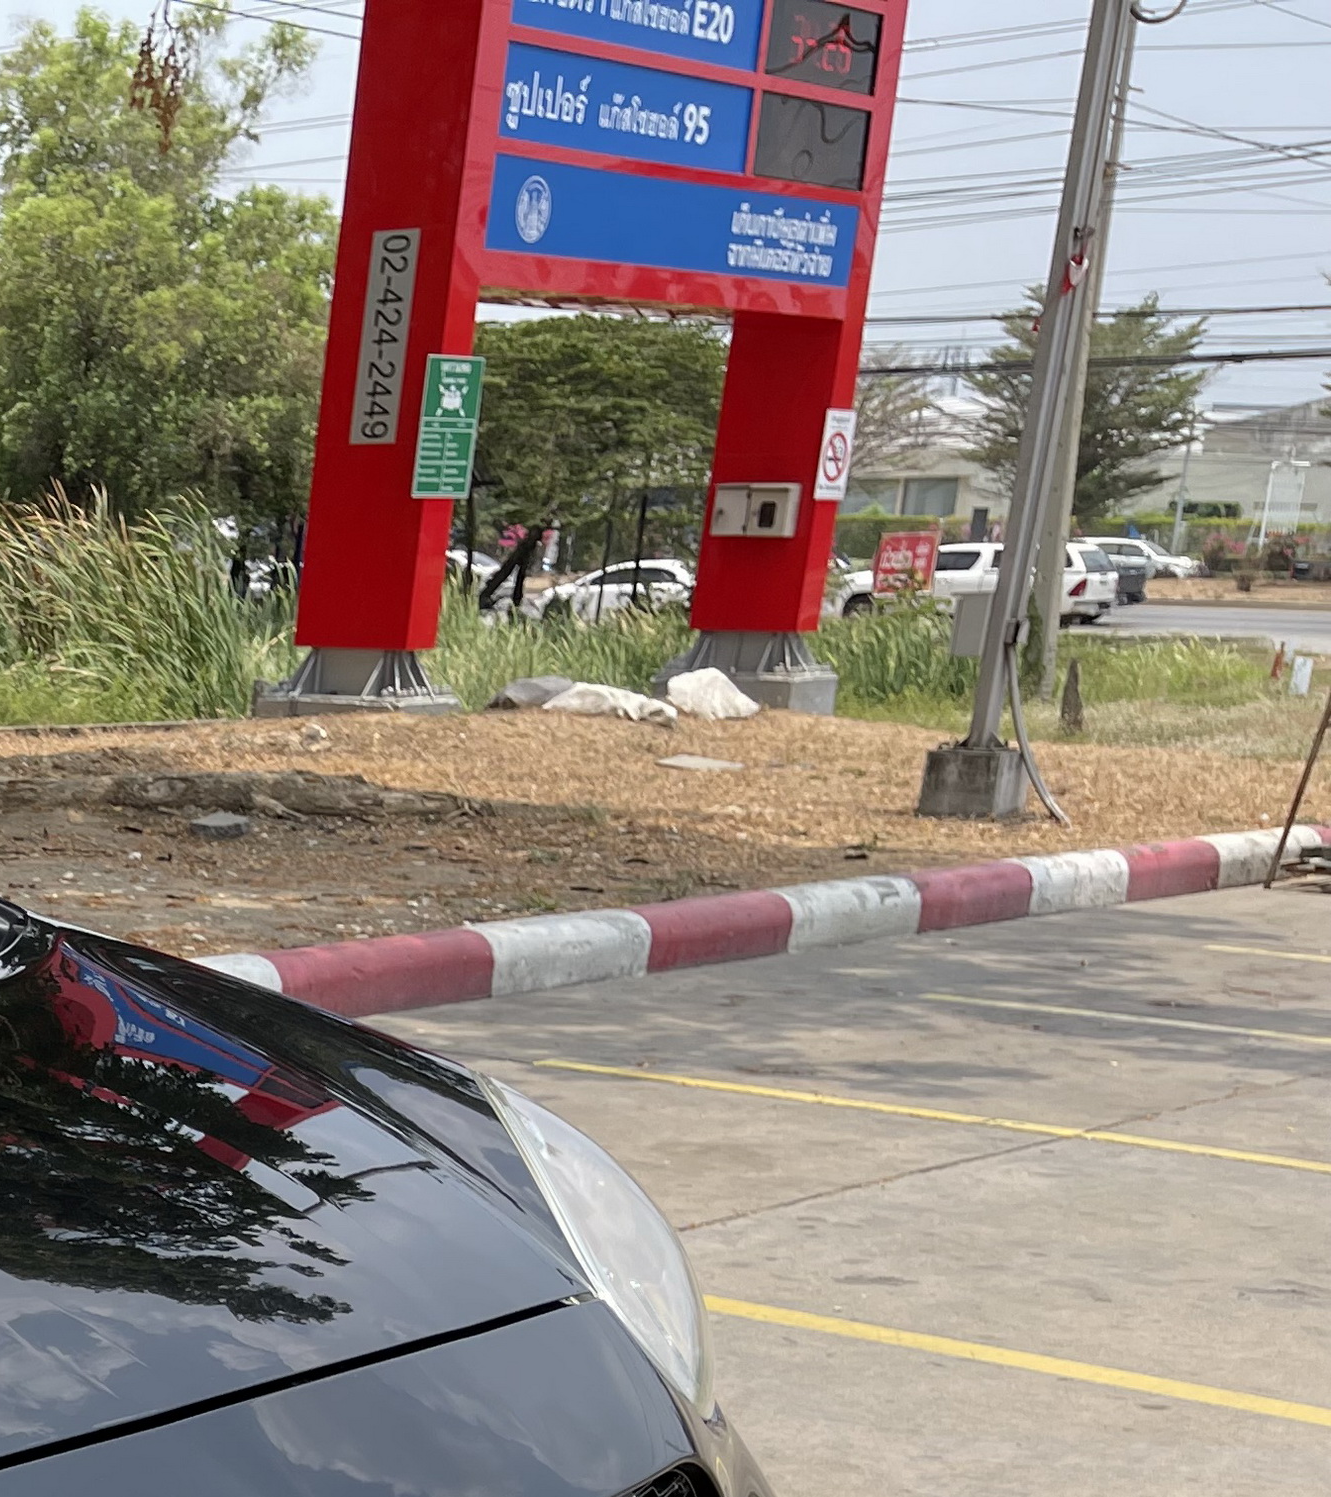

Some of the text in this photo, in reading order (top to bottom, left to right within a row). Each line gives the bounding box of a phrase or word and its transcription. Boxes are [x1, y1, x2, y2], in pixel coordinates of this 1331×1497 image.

[692, 1, 735, 44] E20
[683, 103, 712, 146] 95
[360, 234, 412, 439] 02-424-2449
